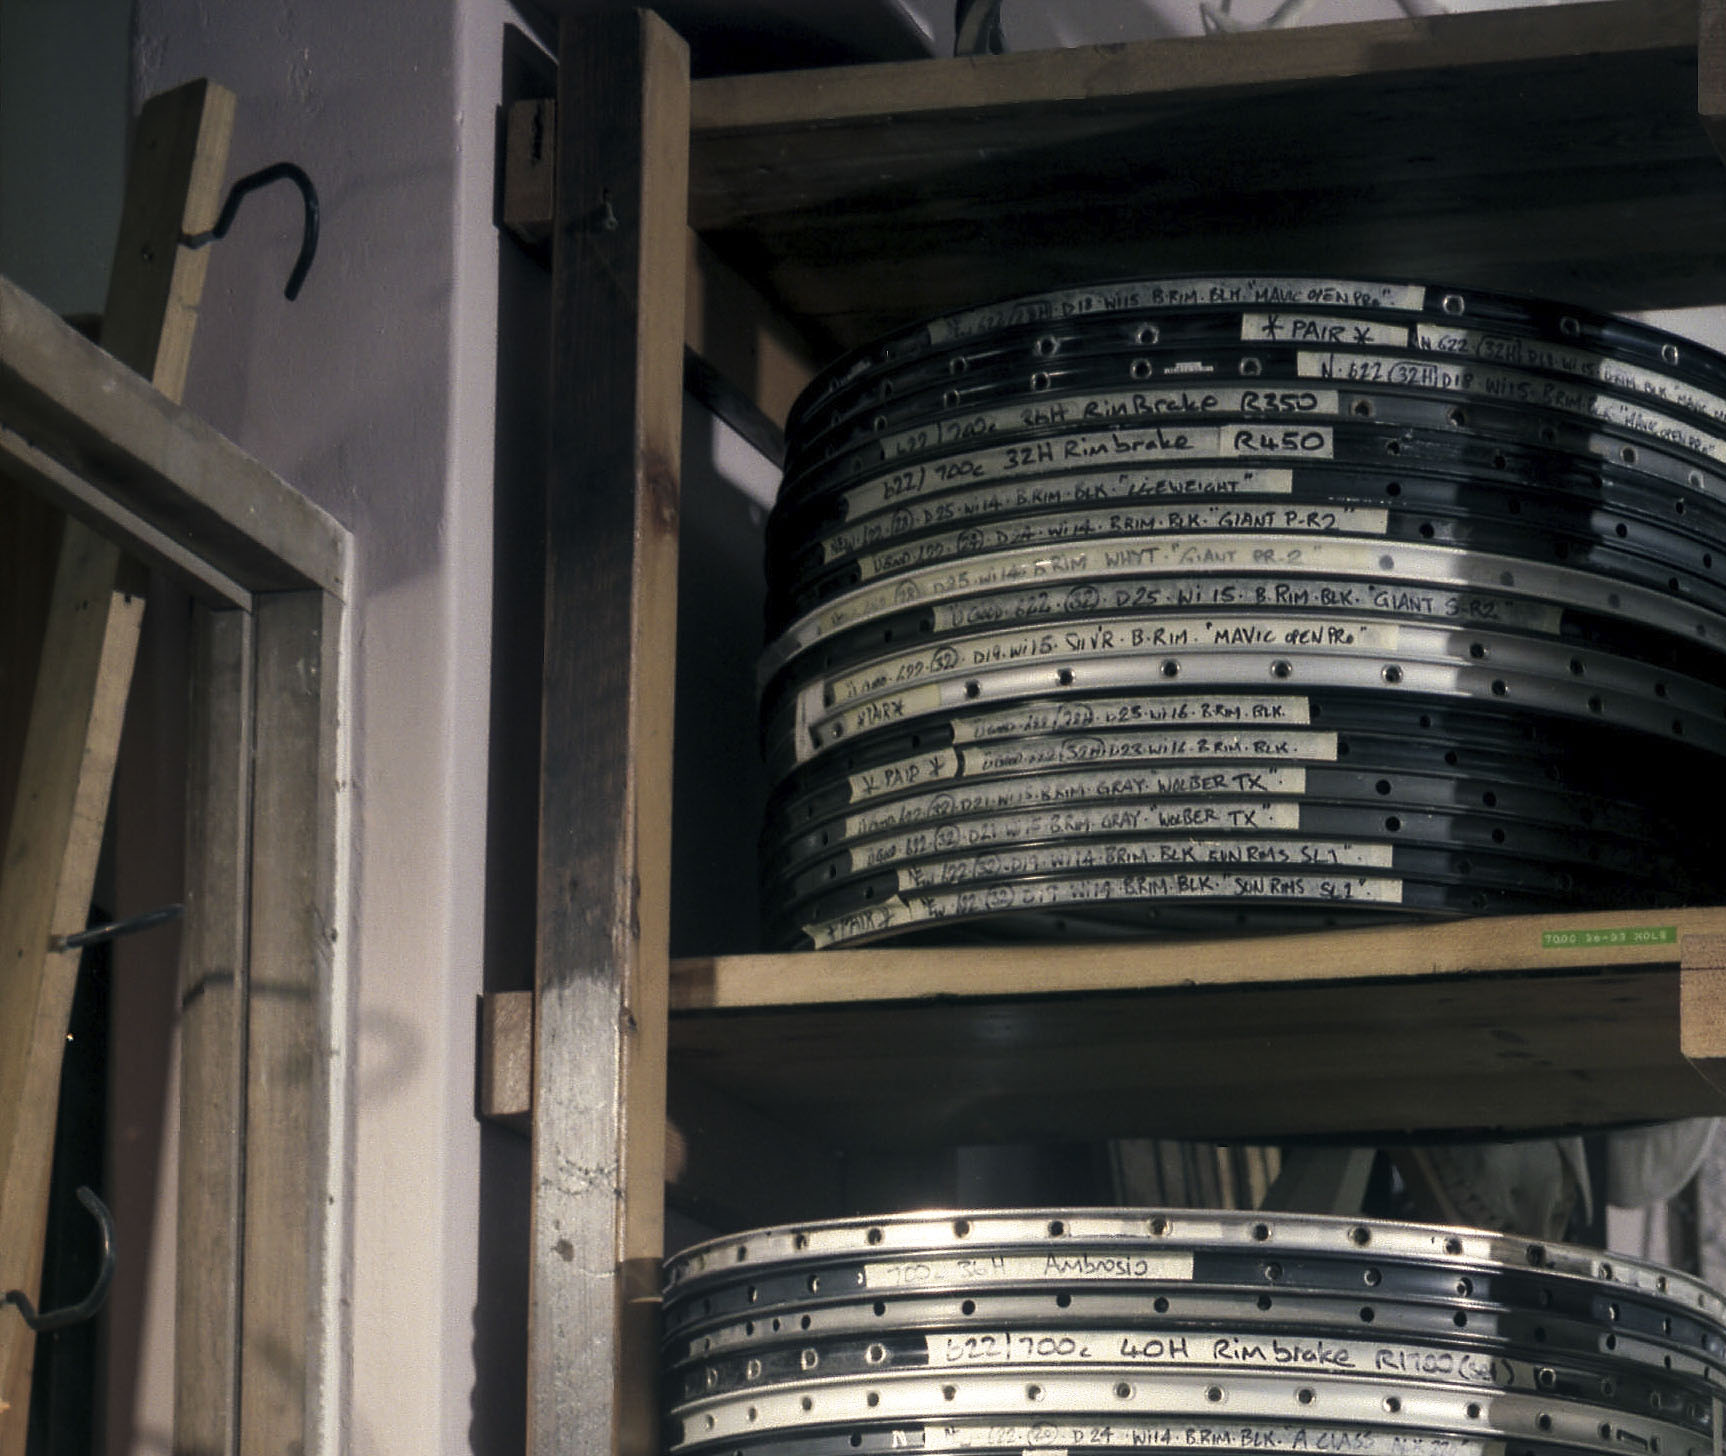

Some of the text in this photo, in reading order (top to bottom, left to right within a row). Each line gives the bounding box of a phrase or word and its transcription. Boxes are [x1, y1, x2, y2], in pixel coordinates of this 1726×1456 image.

[1292, 320, 1345, 341] PAIR
[1438, 335, 1468, 352] 622
[1349, 363, 1381, 381] 622
[1241, 392, 1317, 413] R350
[1004, 443, 1052, 470] 32H
[1234, 431, 1324, 450] R450
[1116, 588, 1159, 606] D25
[1097, 777, 1144, 795] GRAY
[1102, 810, 1141, 828] GRAY
[1045, 1252, 1147, 1276] Ambrosio
[1121, 1338, 1189, 1358] 40H
